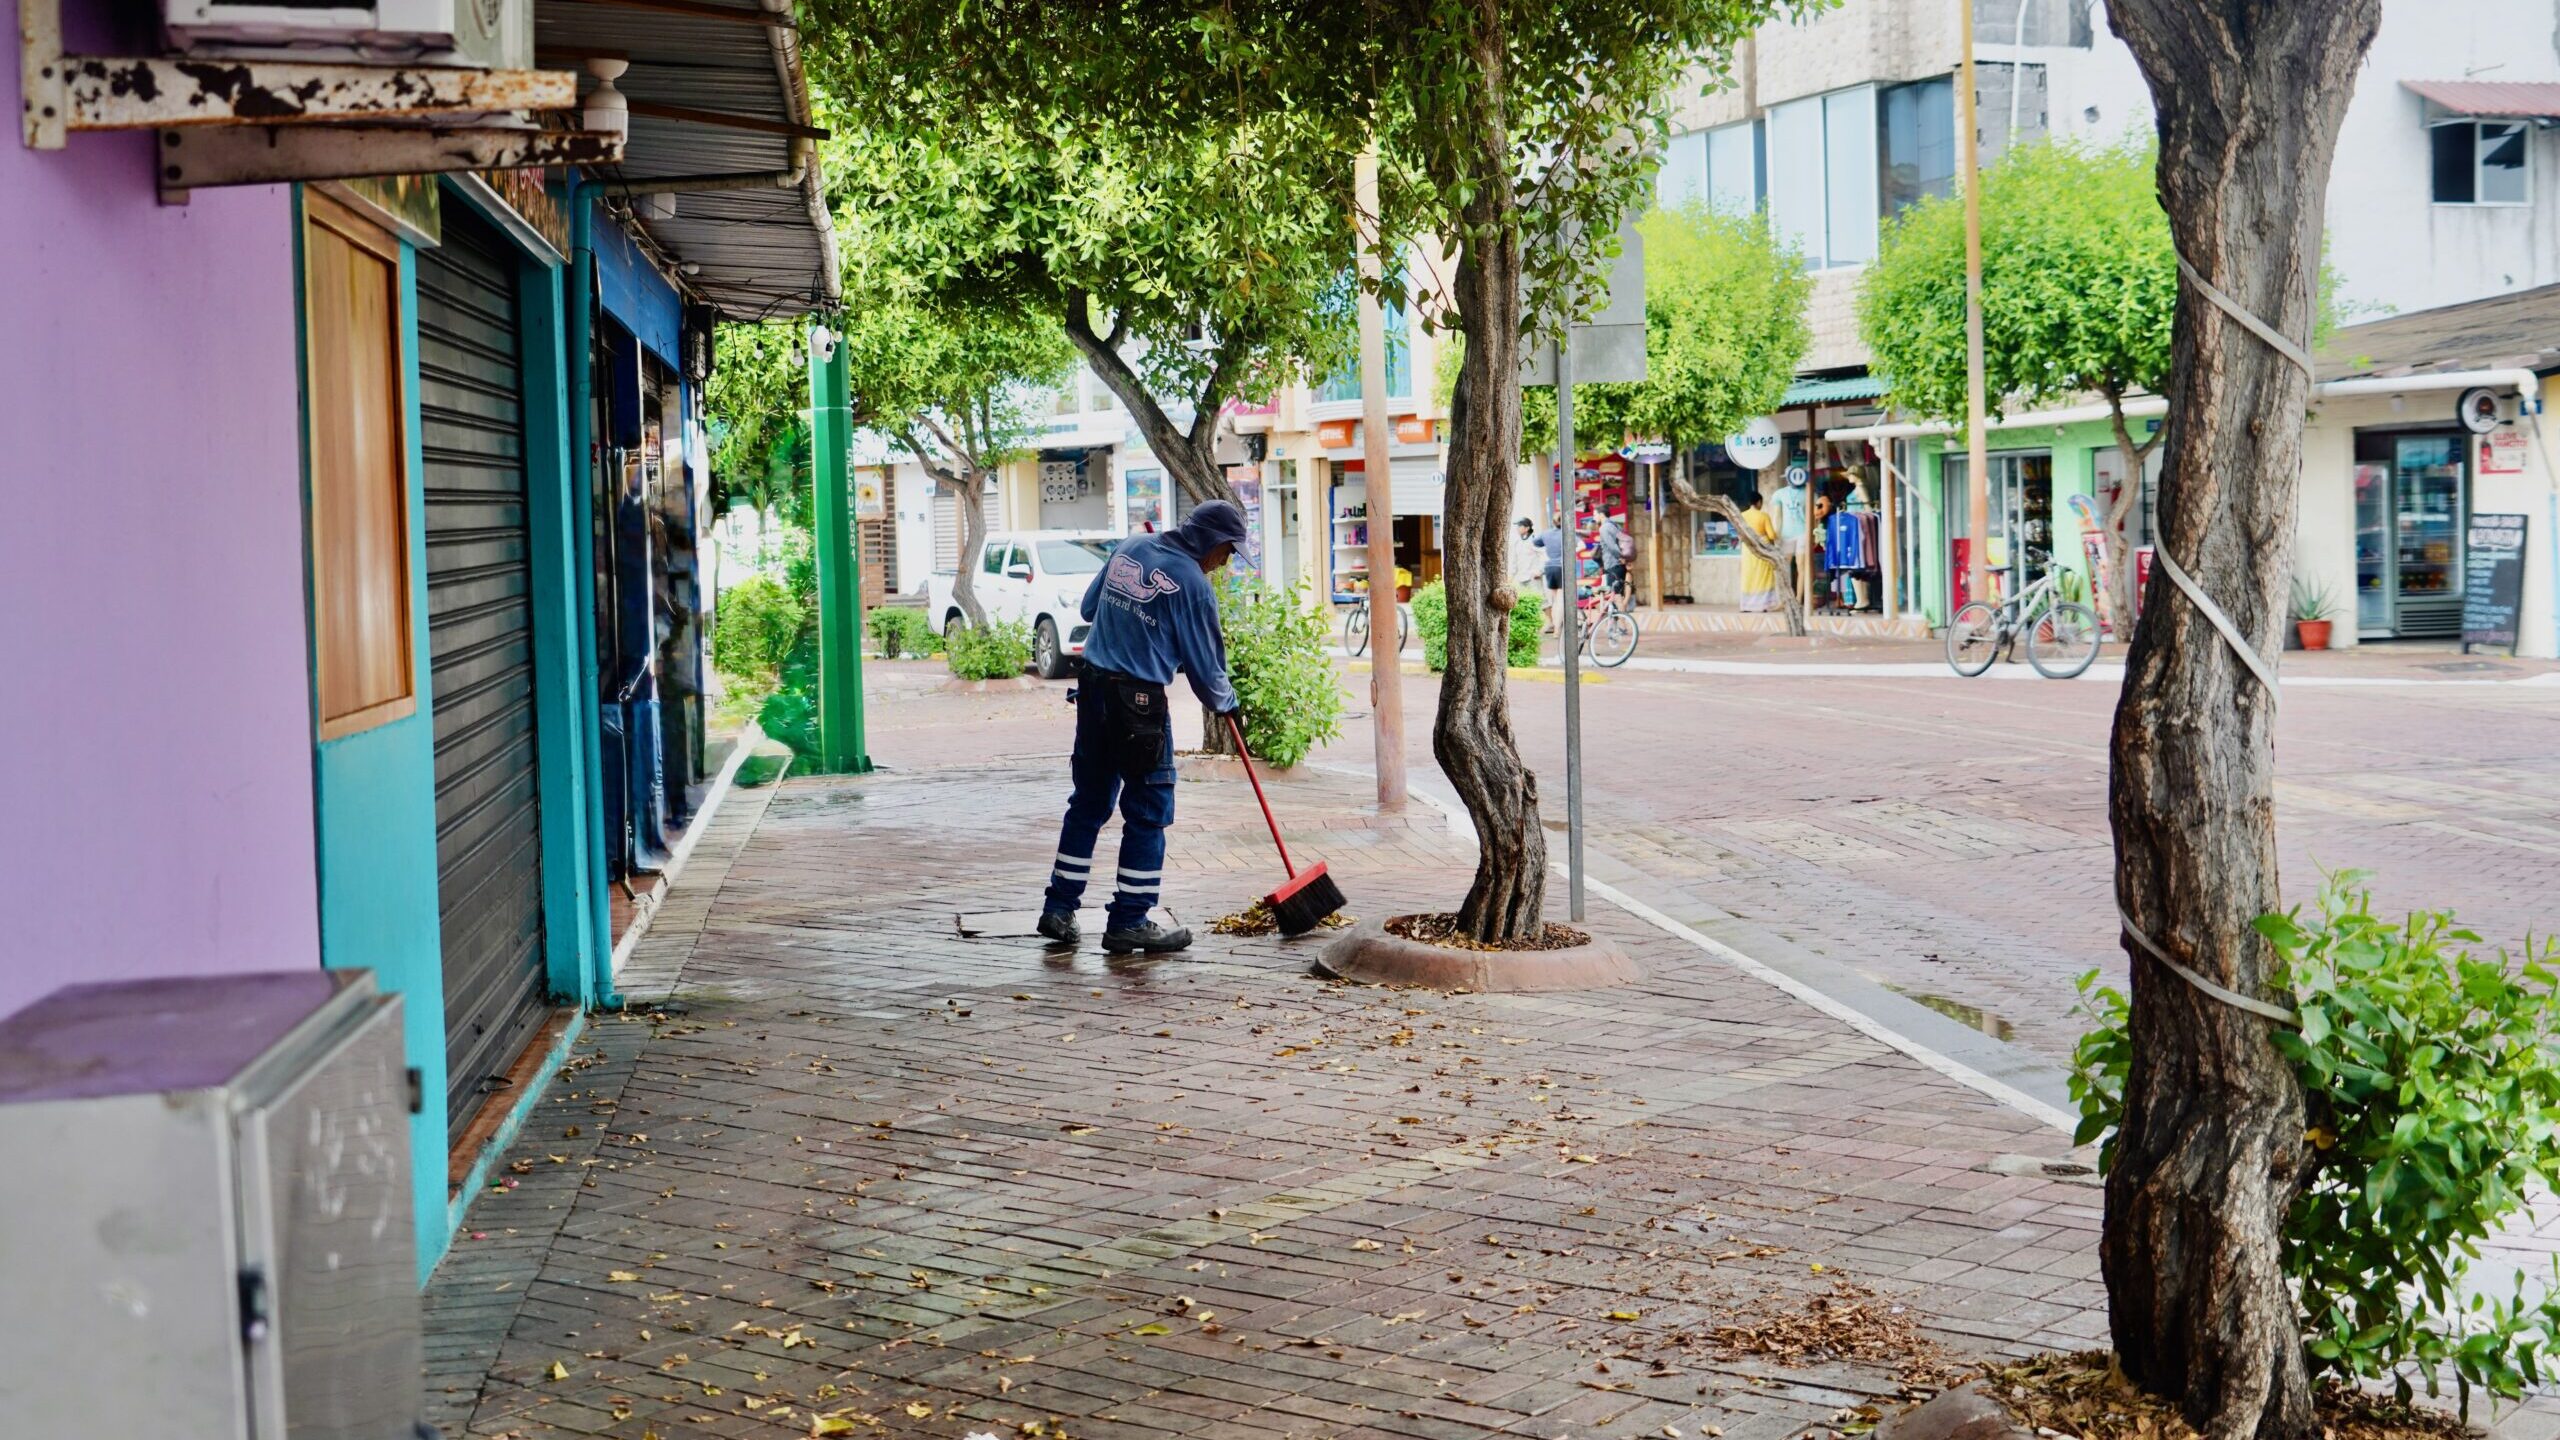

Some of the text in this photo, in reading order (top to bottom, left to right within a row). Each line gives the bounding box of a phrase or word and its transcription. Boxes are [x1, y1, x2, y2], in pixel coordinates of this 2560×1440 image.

[1746, 436, 1777, 447] Ikga
[846, 448, 856, 561] SCRU-001
[1100, 591, 1157, 627] neyard vines
